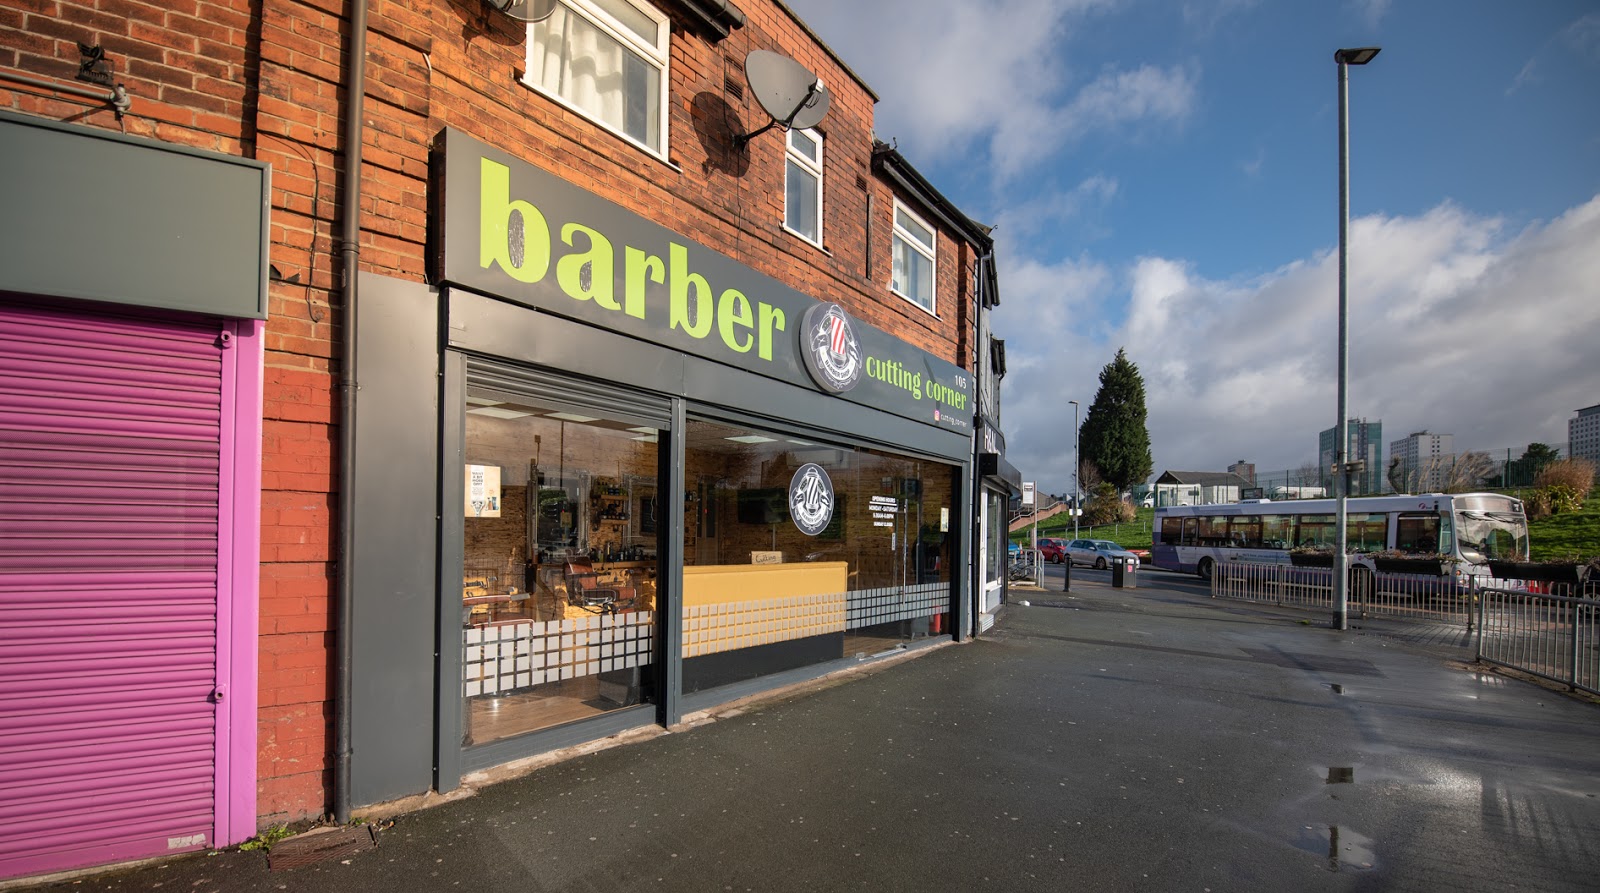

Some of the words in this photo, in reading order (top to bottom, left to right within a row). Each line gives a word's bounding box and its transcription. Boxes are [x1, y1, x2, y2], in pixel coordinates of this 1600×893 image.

[480, 156, 786, 361] barber
[866, 356, 922, 400] cutting
[925, 380, 967, 410] corner
[954, 375, 967, 389] 105
